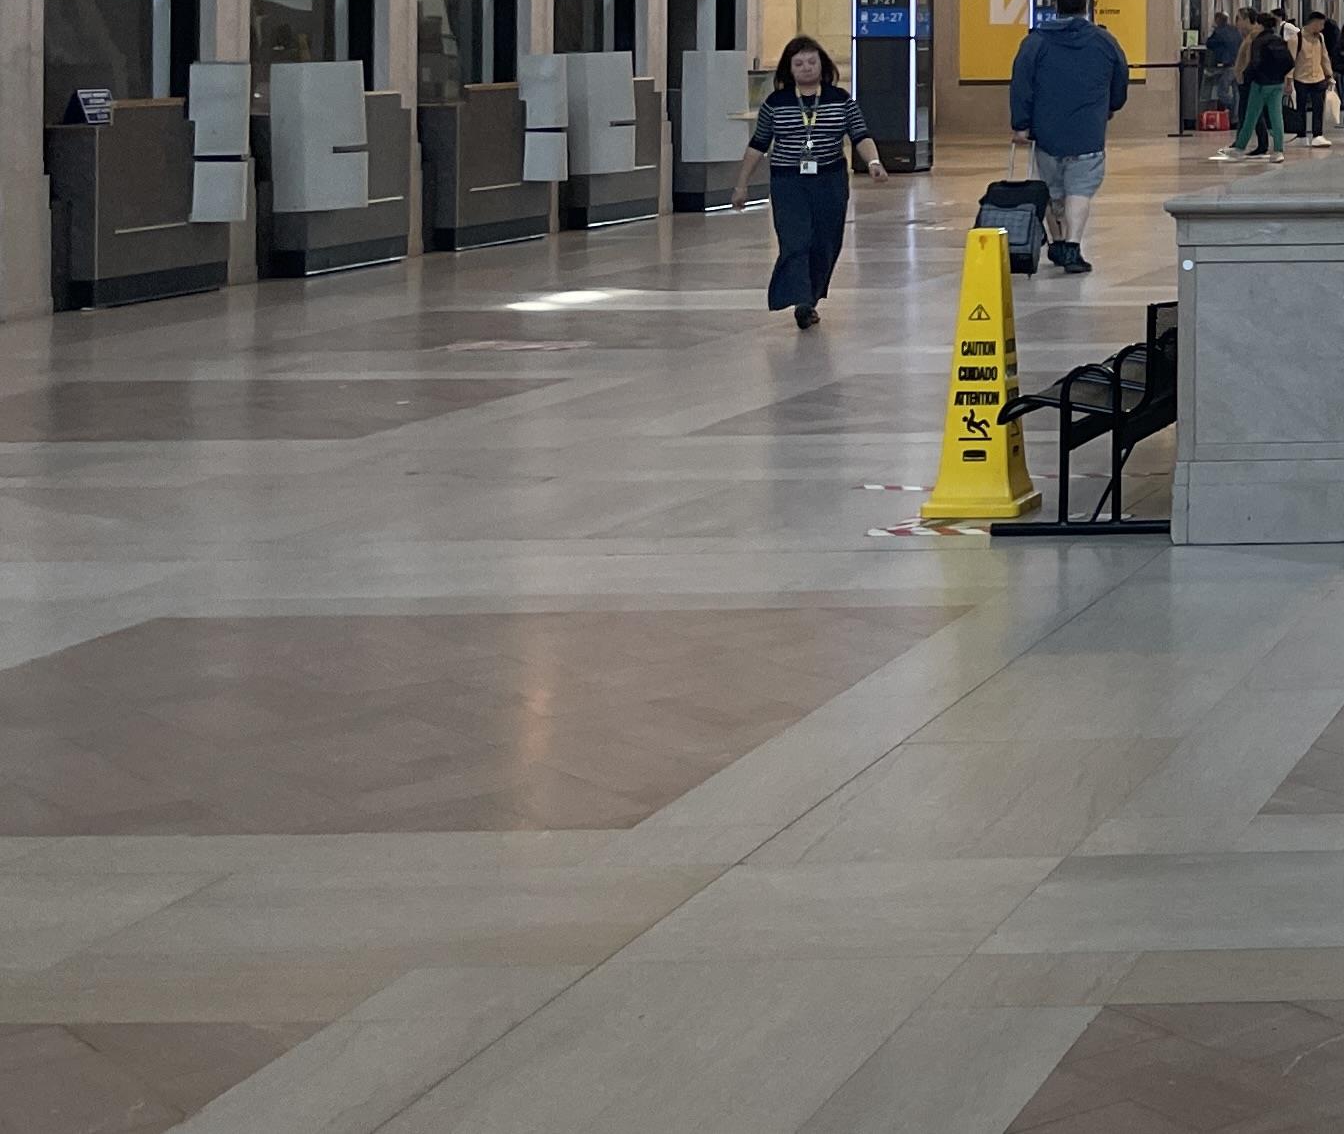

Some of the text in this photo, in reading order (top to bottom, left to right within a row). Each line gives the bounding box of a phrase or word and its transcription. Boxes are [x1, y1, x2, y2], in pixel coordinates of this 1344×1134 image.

[871, 12, 904, 23] 24-27
[961, 341, 997, 356] CAUTION
[958, 366, 998, 381] CUIDADO
[954, 391, 1000, 406] ATTENTION
